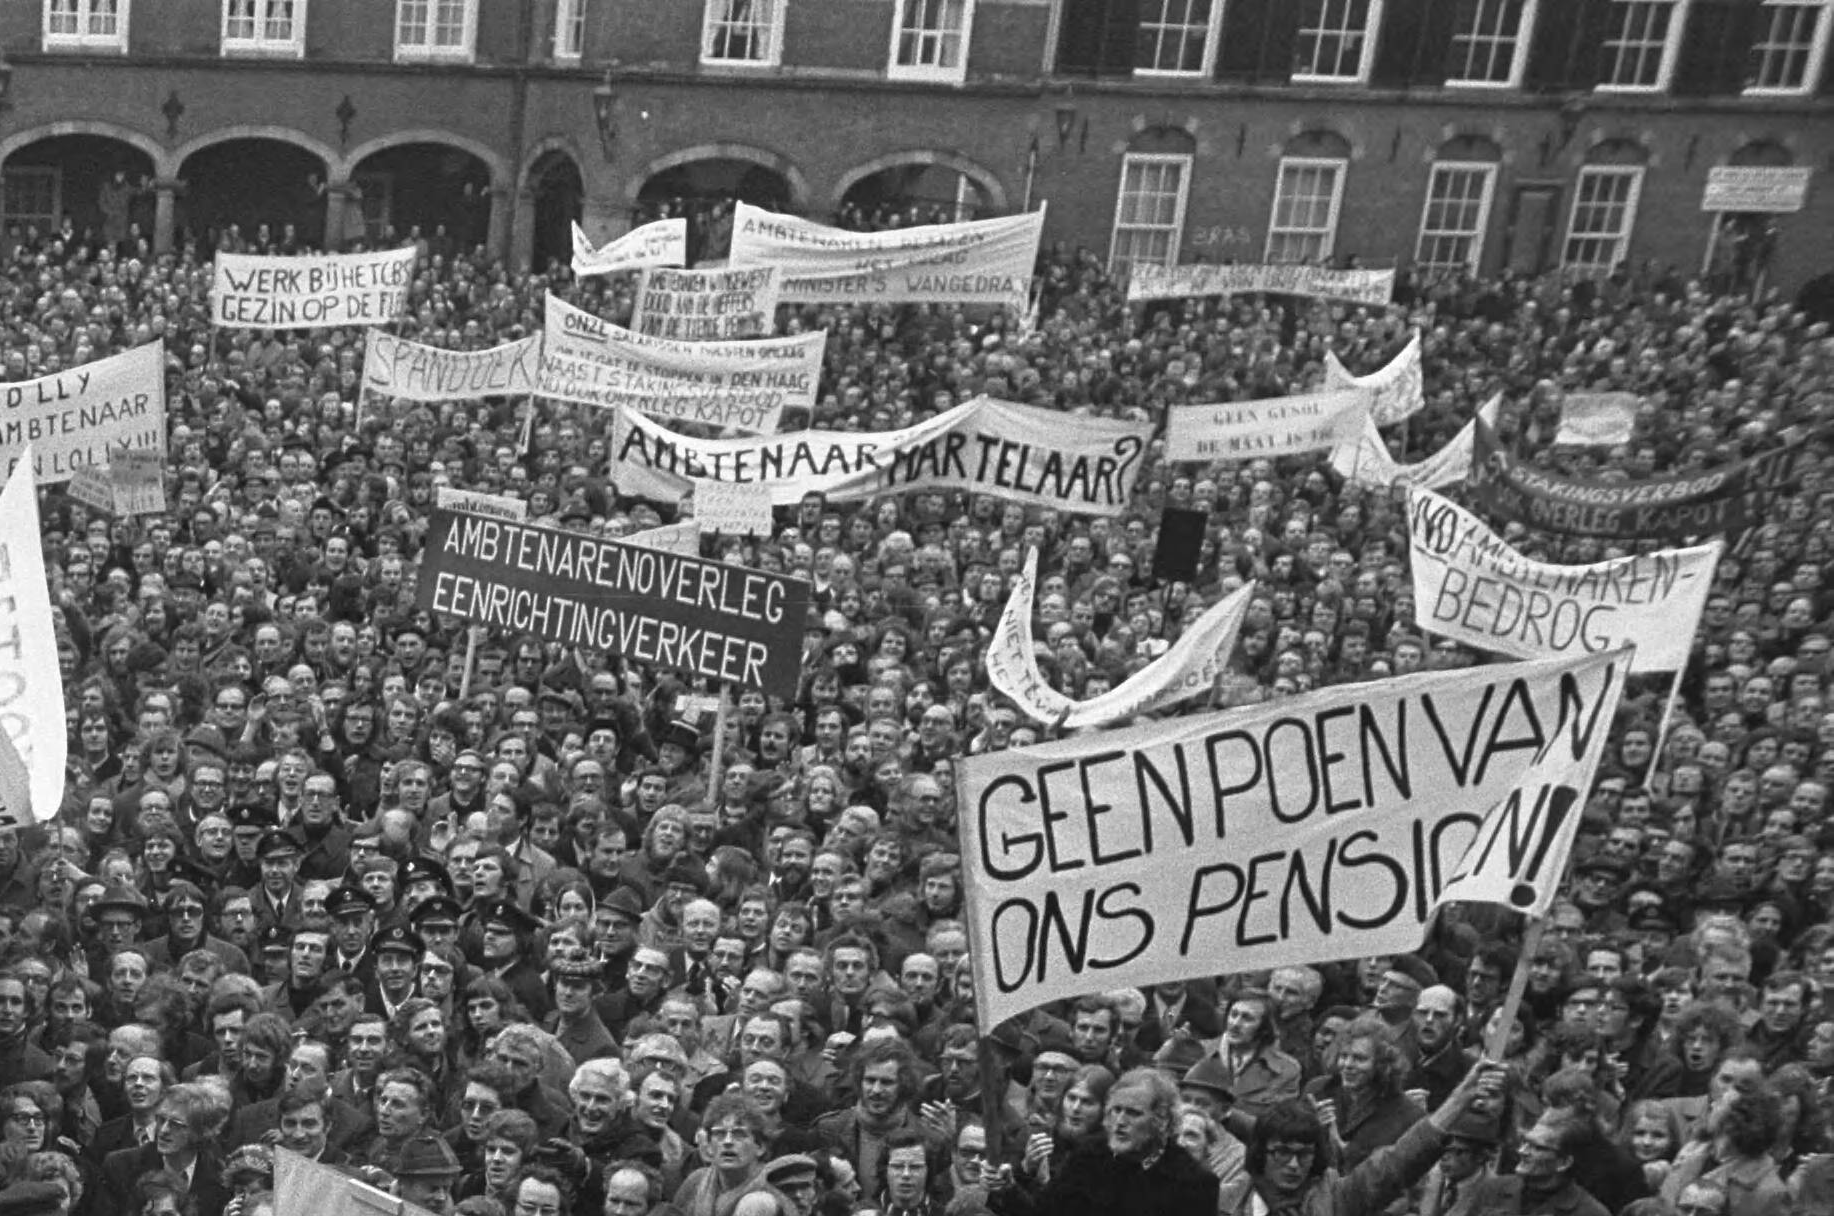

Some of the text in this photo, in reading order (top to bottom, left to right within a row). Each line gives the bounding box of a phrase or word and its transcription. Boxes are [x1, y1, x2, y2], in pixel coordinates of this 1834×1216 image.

[224, 267, 302, 294] WERK
[783, 276, 887, 293] MINISTER'S
[221, 294, 295, 325] GEZIN
[302, 294, 339, 322] OP
[347, 293, 372, 319] DE
[565, 313, 608, 338] ONZE
[543, 350, 602, 383] NAAST
[731, 371, 761, 389] DEN
[765, 372, 811, 391] HAAG
[606, 390, 687, 418] OVERLEG
[694, 398, 767, 429] KAPOT
[618, 425, 1143, 505] AMBTENAAR MARTELAAR?
[1510, 465, 1726, 504] STAKINGSVERBOD
[1531, 499, 1621, 534] OVERLEG
[1635, 498, 1731, 531] KAPOT
[1432, 565, 1617, 653] BEDROG
[432, 570, 768, 688] EENRICHTINGVERKEER
[976, 661, 1614, 882] GEEN POEN VAN
[991, 783, 1578, 996] ONS PENSION!
